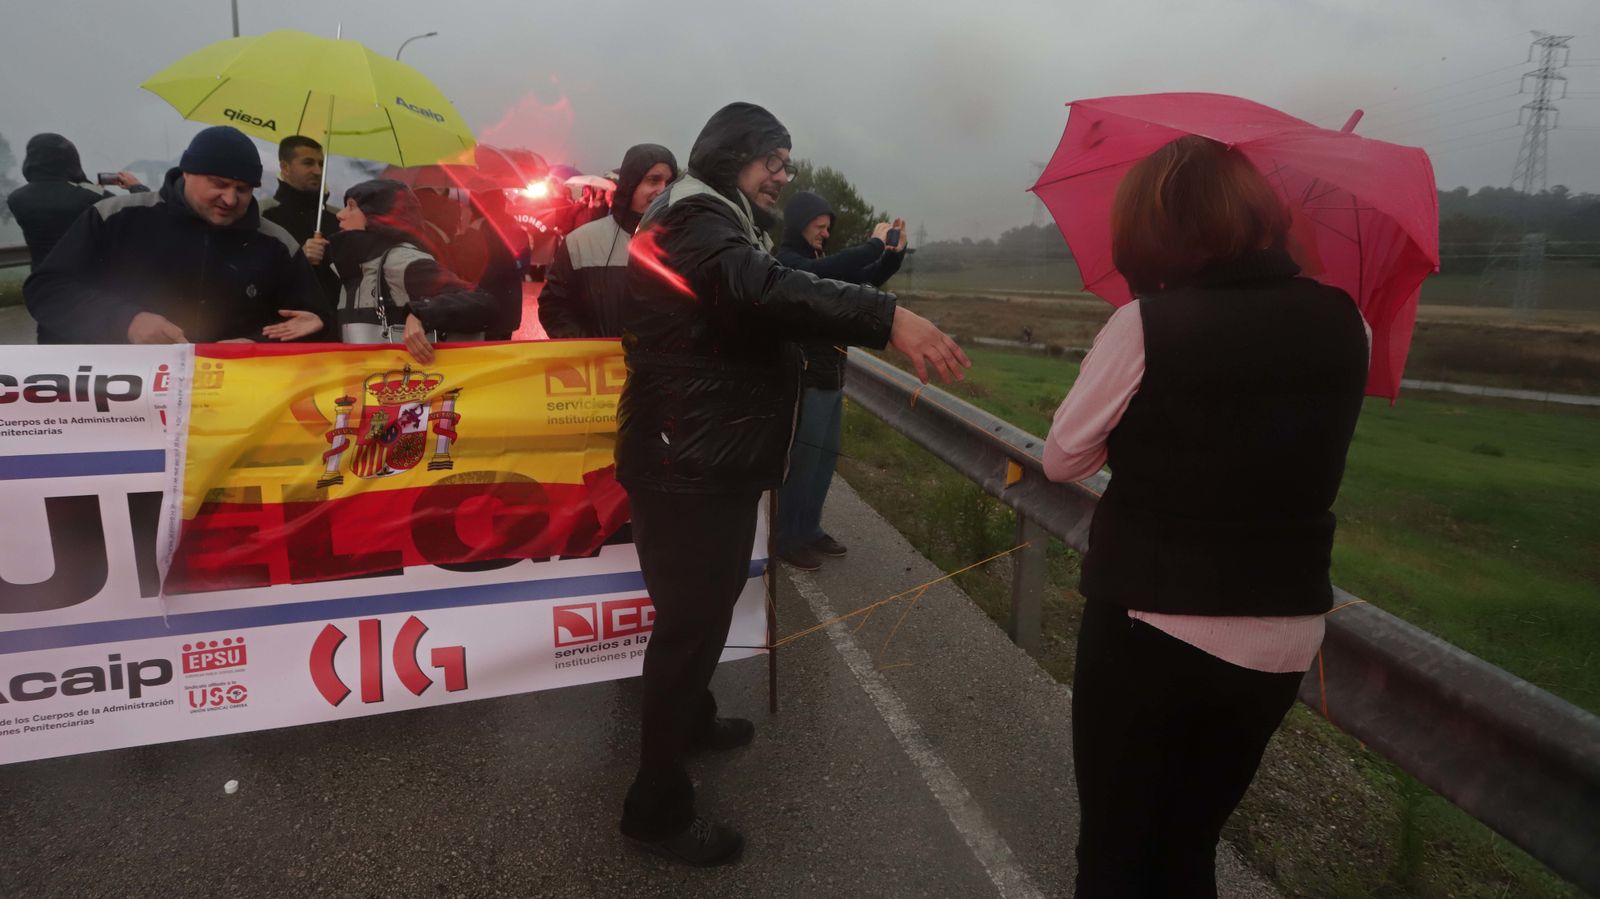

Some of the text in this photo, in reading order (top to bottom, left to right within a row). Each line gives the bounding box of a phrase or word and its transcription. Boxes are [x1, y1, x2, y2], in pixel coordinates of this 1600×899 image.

[43, 417, 57, 425] de
[58, 416, 68, 425] la
[71, 414, 146, 424] Administración
[188, 648, 240, 670] EPSU
[555, 635, 648, 659] servicios a la
[309, 614, 469, 707] CIG
[555, 649, 646, 670] instituciones pe
[0, 653, 173, 704] caip
[188, 684, 247, 708] USO
[32, 711, 75, 723] Cuerpos
[77, 709, 89, 717] de
[91, 707, 101, 715] la
[102, 699, 175, 714] Administración
[23, 718, 95, 733] Penitenciarias
